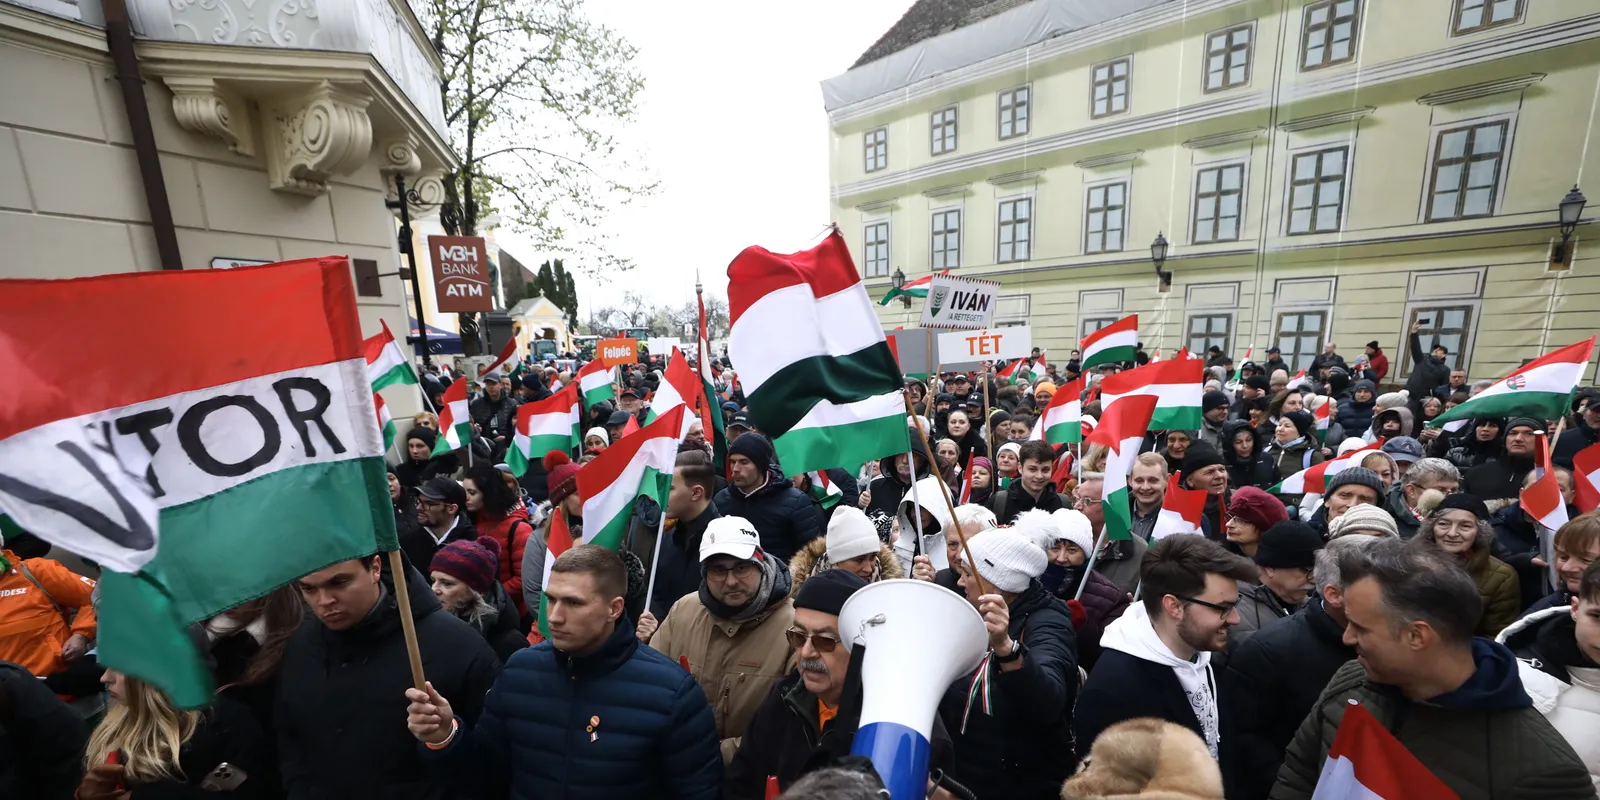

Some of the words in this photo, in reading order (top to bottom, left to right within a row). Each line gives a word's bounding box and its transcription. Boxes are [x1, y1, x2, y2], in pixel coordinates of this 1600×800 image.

[439, 245, 478, 262] MBH
[441, 262, 480, 275] BANK
[446, 283, 483, 297] ATM
[950, 288, 991, 312] IVÁN
[965, 331, 1003, 356] TÉT
[603, 345, 631, 359] Felpéc
[0, 587, 27, 598] IDESZ
